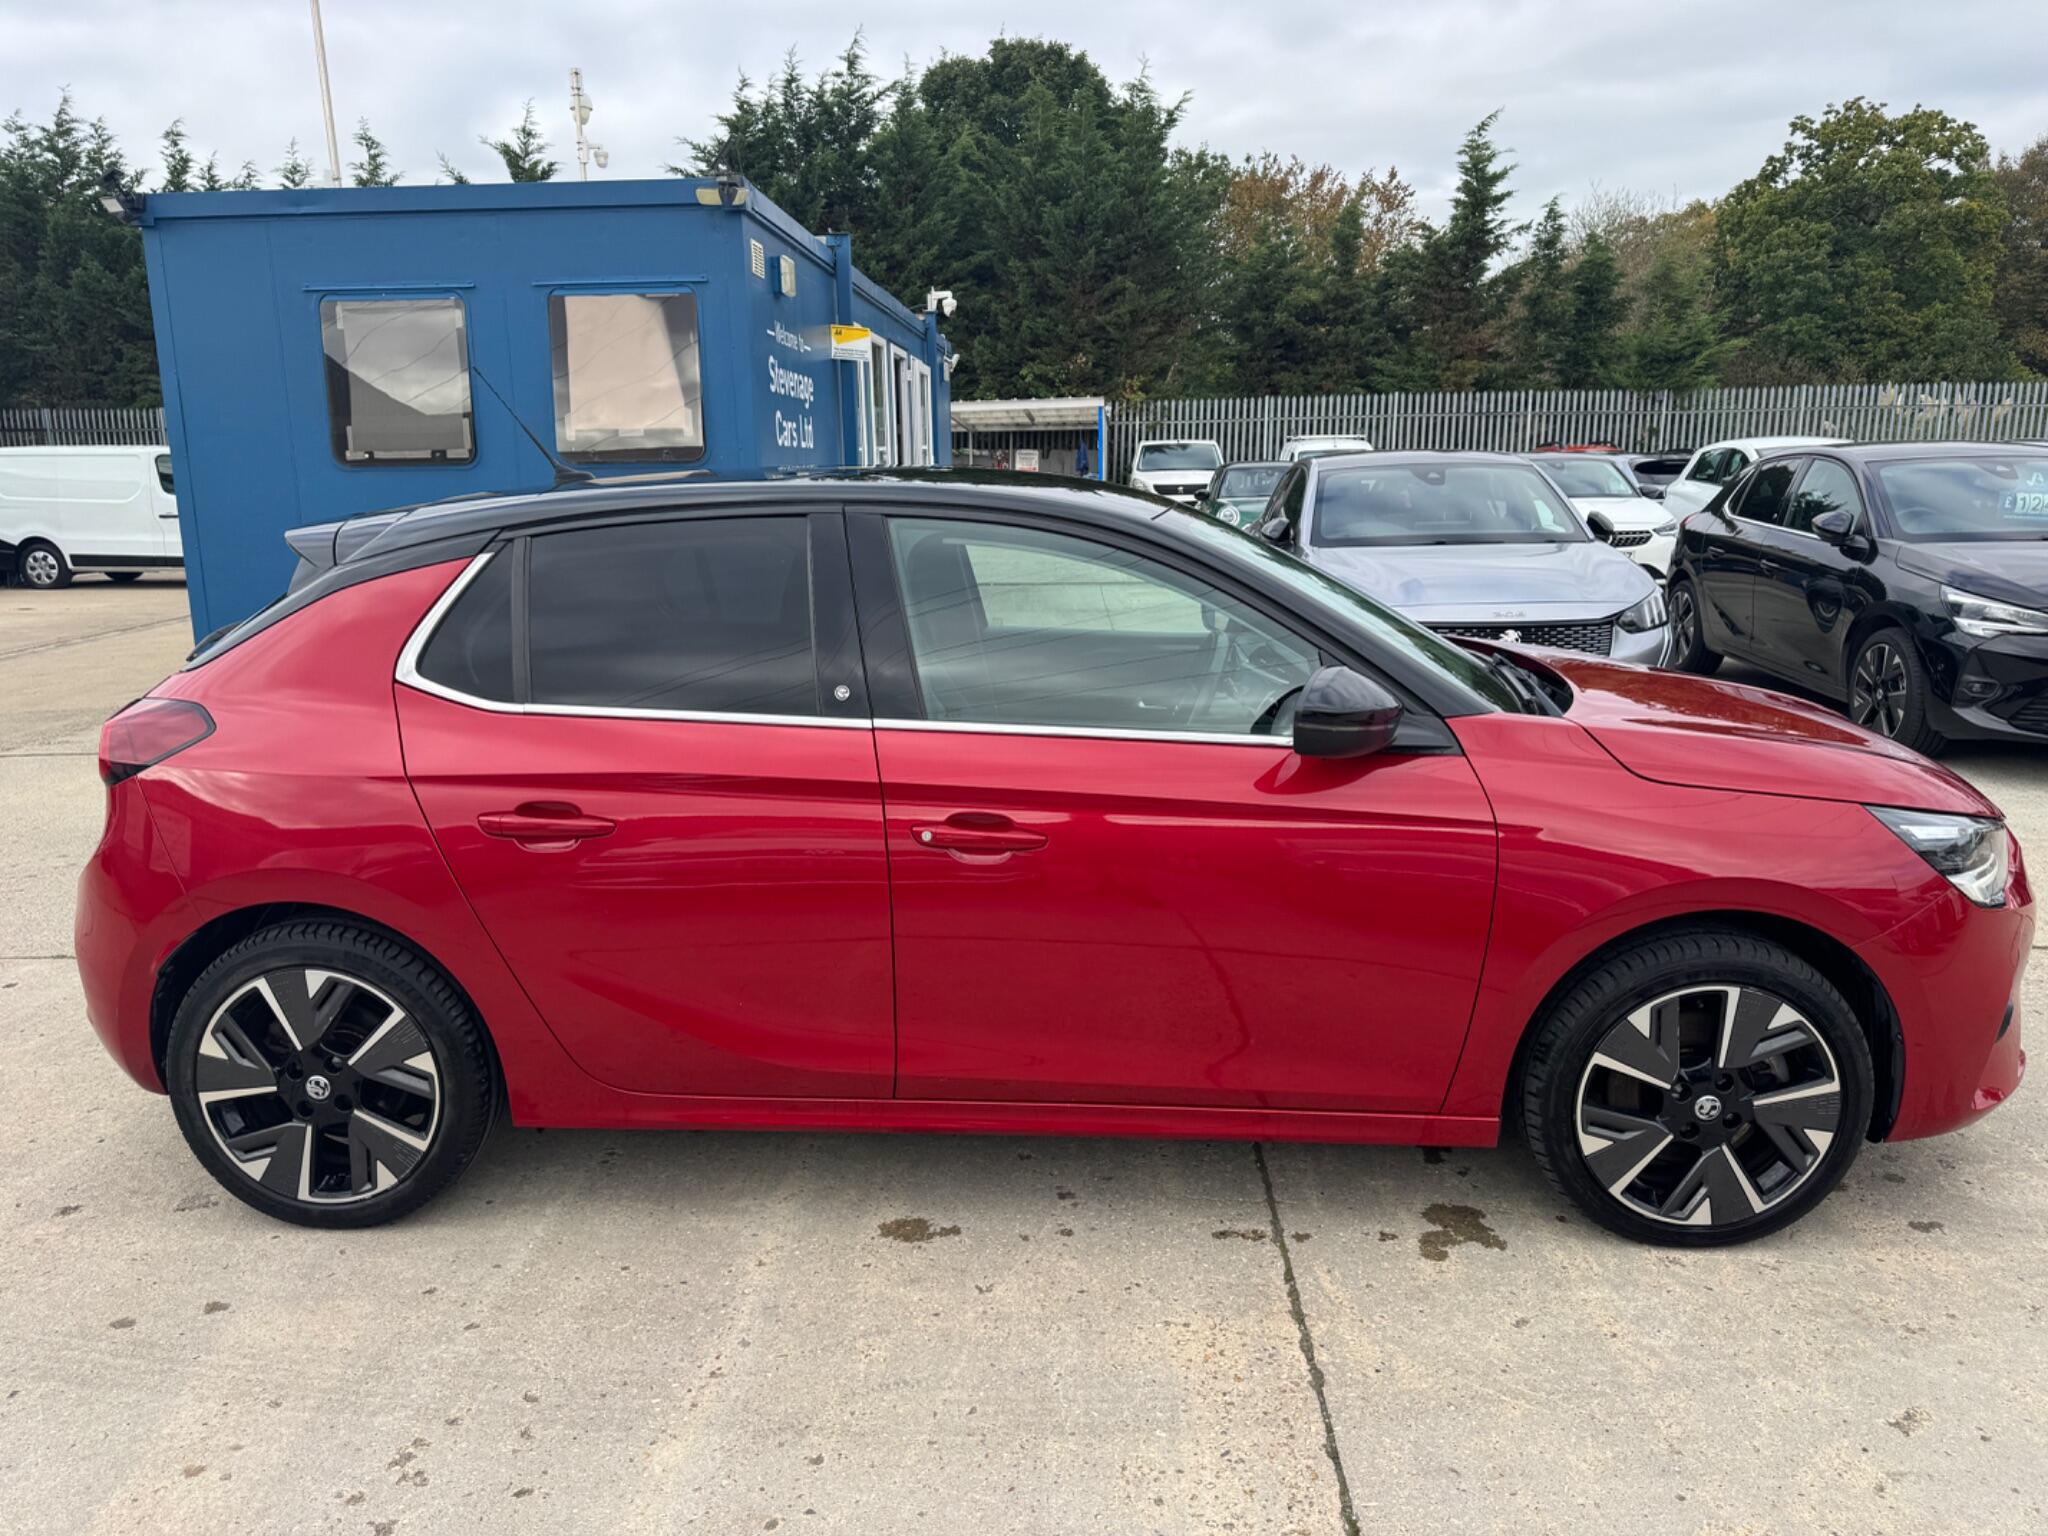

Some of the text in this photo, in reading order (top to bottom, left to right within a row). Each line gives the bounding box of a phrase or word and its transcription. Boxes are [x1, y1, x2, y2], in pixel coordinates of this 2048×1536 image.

[775, 319, 798, 351] Welcome
[768, 354, 814, 409] Stevenage
[775, 409, 814, 449] Cars Ltd
